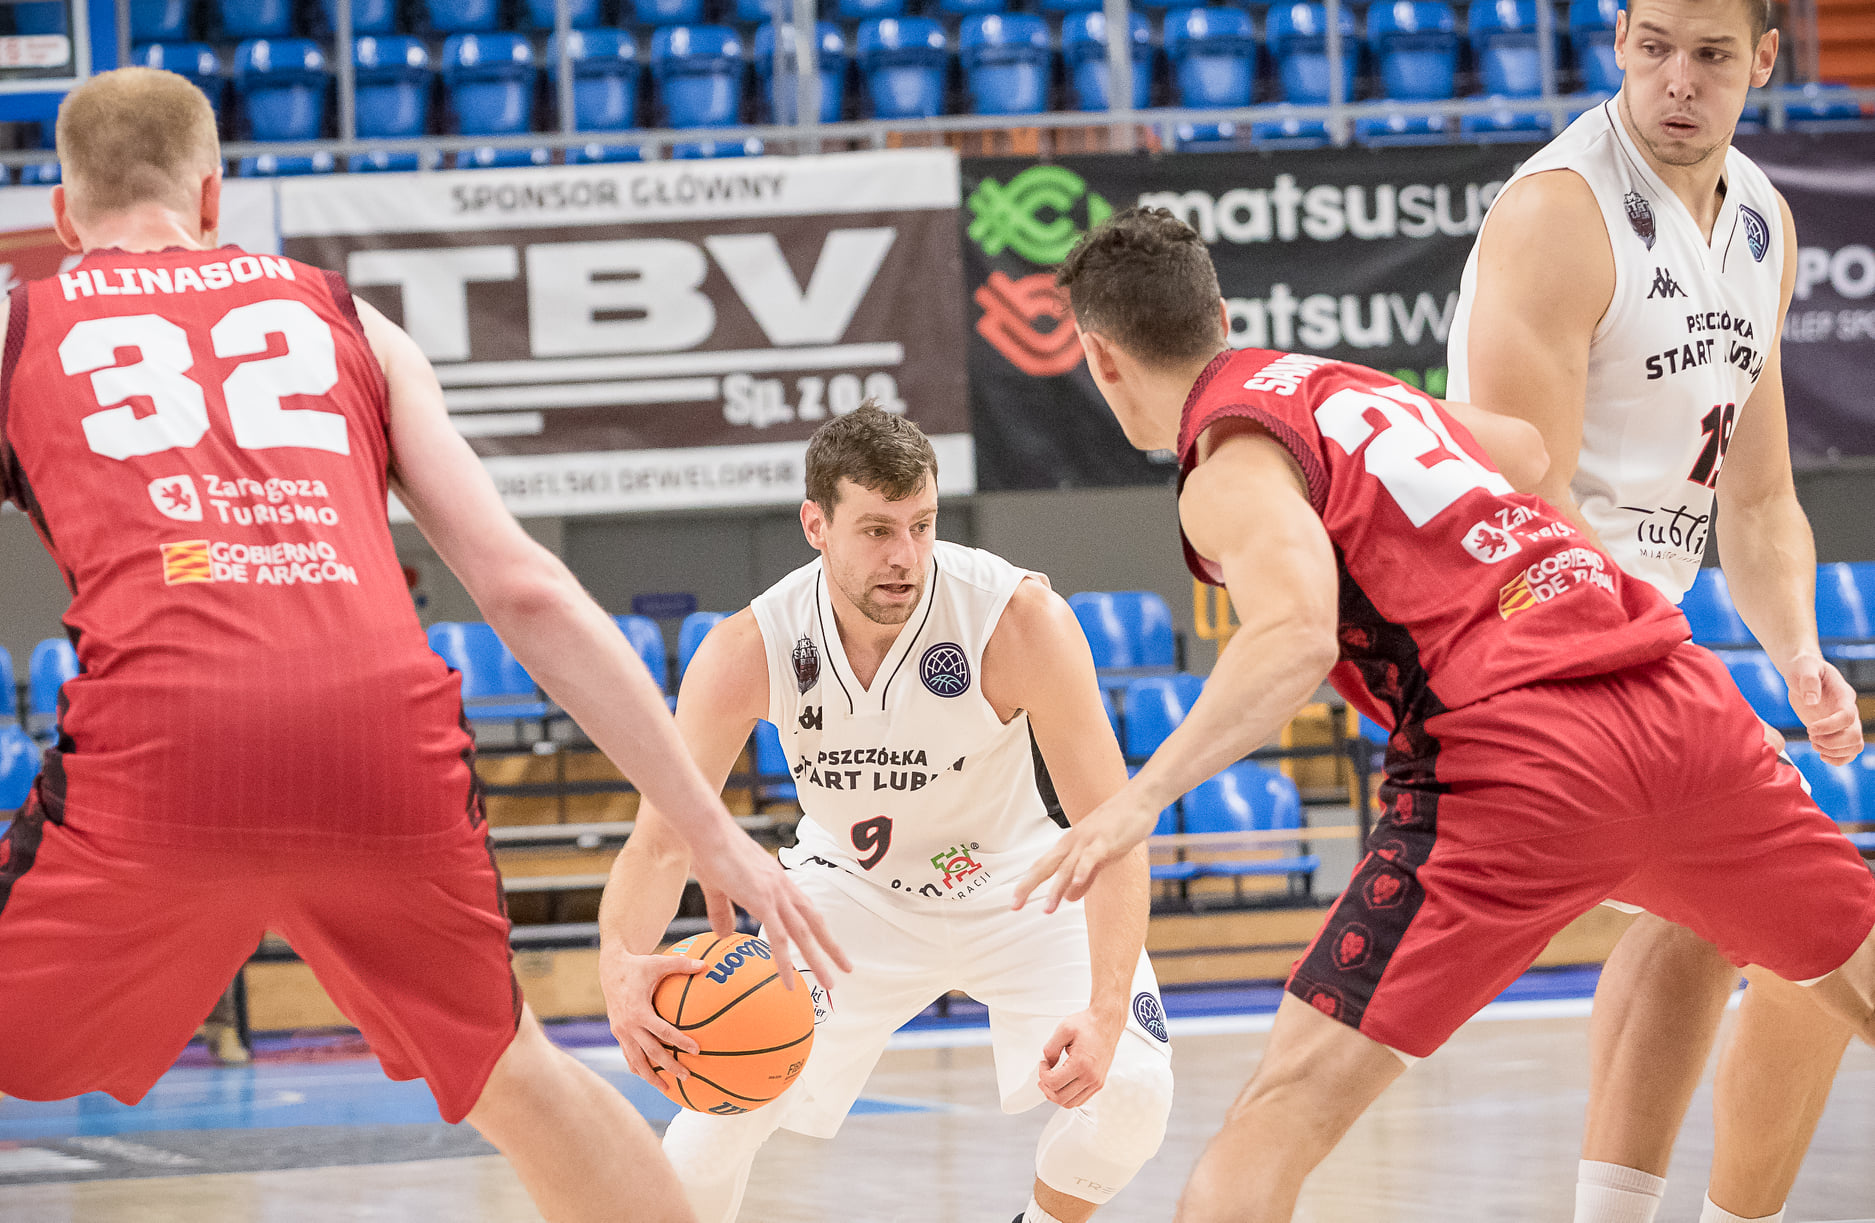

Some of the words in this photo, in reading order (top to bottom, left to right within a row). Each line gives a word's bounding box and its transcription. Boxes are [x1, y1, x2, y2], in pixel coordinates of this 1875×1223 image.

[450, 178, 618, 212] SPONSOR
[631, 172, 785, 206] GŁÓWNY
[58, 256, 296, 301] HLINASON
[1794, 244, 1875, 300] PO
[347, 226, 897, 361] TBV
[1227, 283, 1460, 350] atsuw
[57, 299, 351, 461] 32
[1645, 338, 1714, 380] START
[202, 474, 329, 504] Zaragoza
[211, 541, 337, 566] GOBIERNO
[214, 562, 249, 584] DE
[1534, 572, 1571, 604] DE
[817, 747, 928, 767] PSZCZÓŁKA
[850, 815, 893, 872] 9
